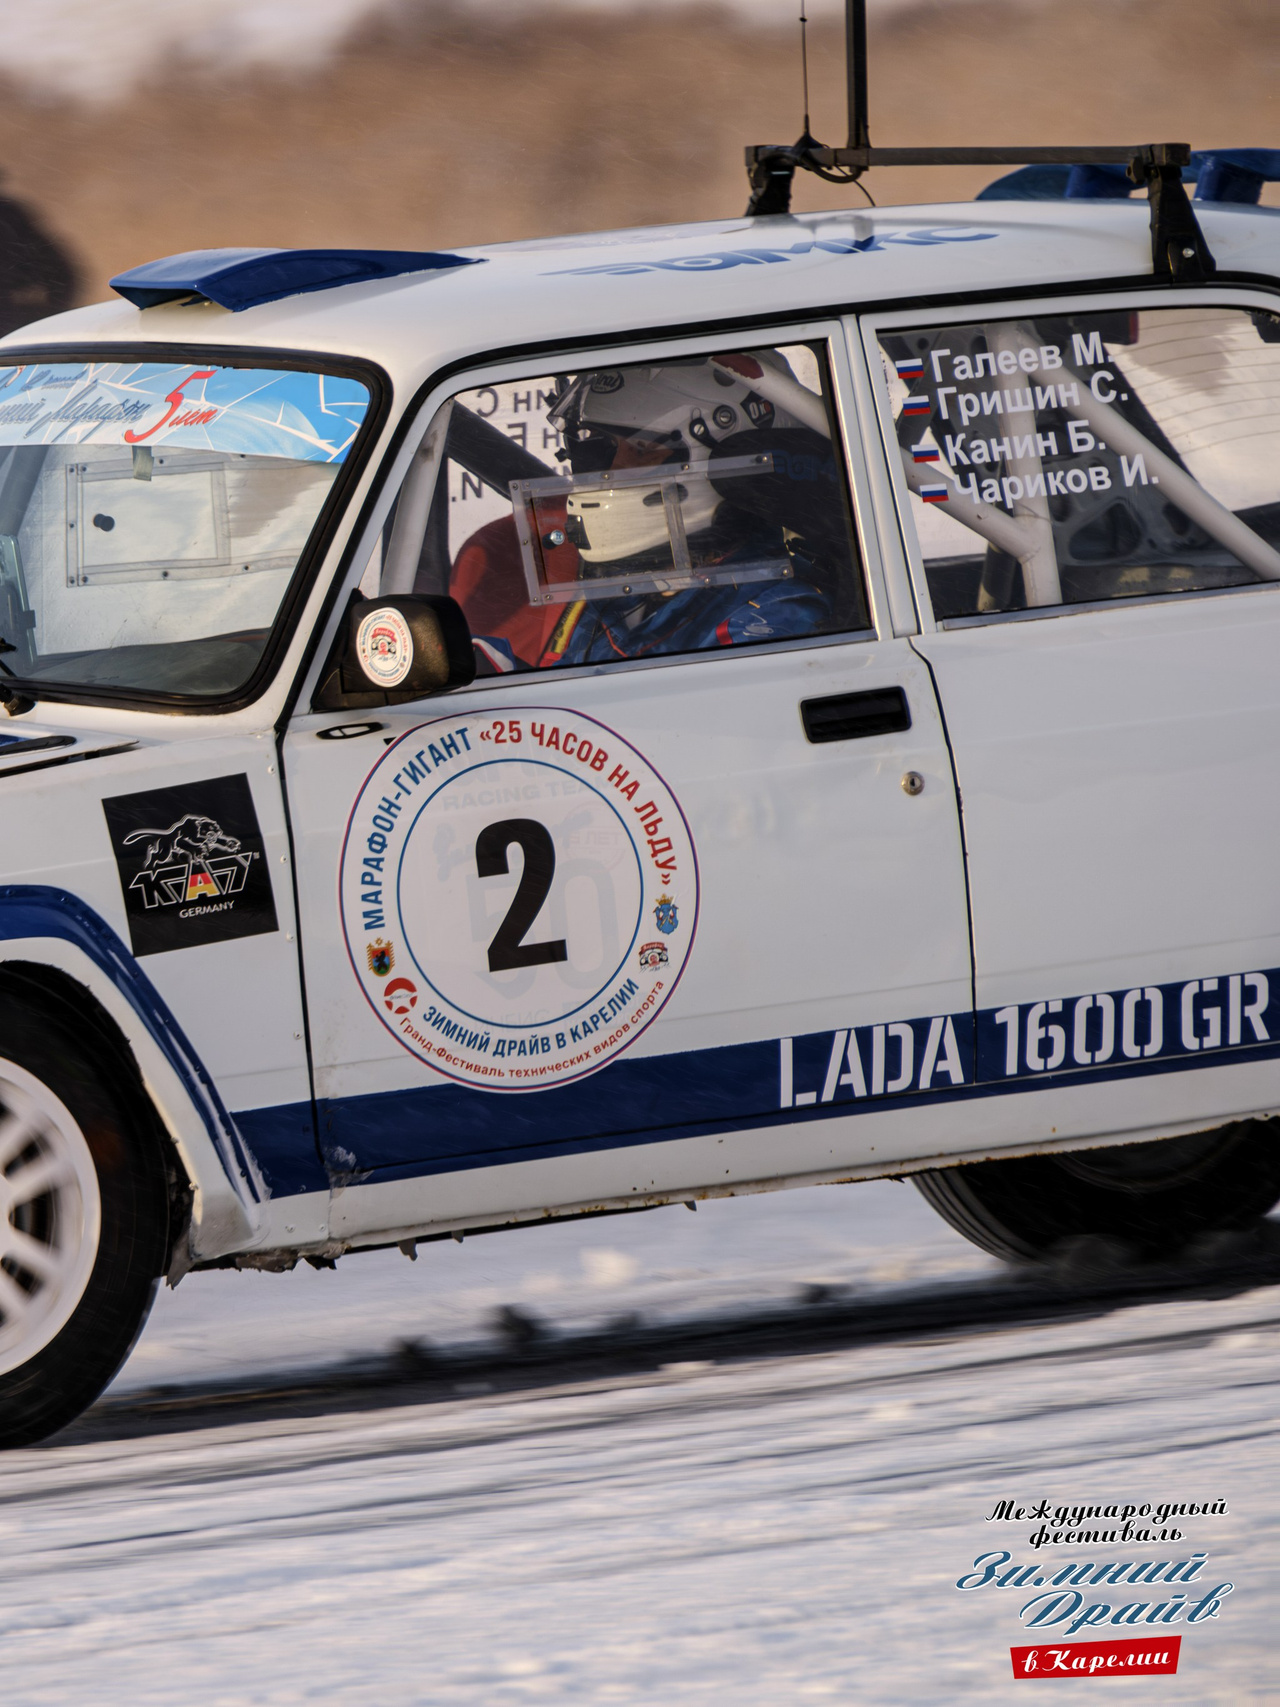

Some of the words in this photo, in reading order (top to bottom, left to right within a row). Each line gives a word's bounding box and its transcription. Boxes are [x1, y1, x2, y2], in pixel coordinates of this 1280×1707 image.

[931, 344, 1063, 383] Галеев
[1072, 331, 1116, 367] М.
[124, 370, 218, 443] 5
[936, 382, 1080, 426] Гришин
[1090, 370, 1129, 403] С.
[945, 430, 1059, 467] Канин
[1067, 420, 1106, 453] Б.
[953, 466, 1112, 509] Чариков
[1120, 454, 1159, 488] И.
[361, 727, 473, 930] МАРАФОН-ГИГАНТ
[480, 720, 522, 745] «25
[530, 722, 610, 773] ЧАСОВ
[607, 763, 642, 802] НА
[634, 800, 679, 886] ЛЬДУ»
[179, 900, 235, 919] GERMANY
[475, 818, 568, 973] 2
[400, 1017, 506, 1078] Гранд-Фестиваль
[509, 1050, 592, 1078] технических
[593, 1023, 631, 1054] видов
[631, 980, 664, 1024] спорта
[423, 1006, 491, 1053] ЗИМНИЙ
[492, 1034, 551, 1058] ДРАЙВ
[555, 1032, 568, 1049] В
[569, 978, 640, 1043] КАРЕЛИИ
[780, 1015, 965, 1109] LADA
[995, 986, 1164, 1076] 1600
[1181, 972, 1271, 1052] GR
